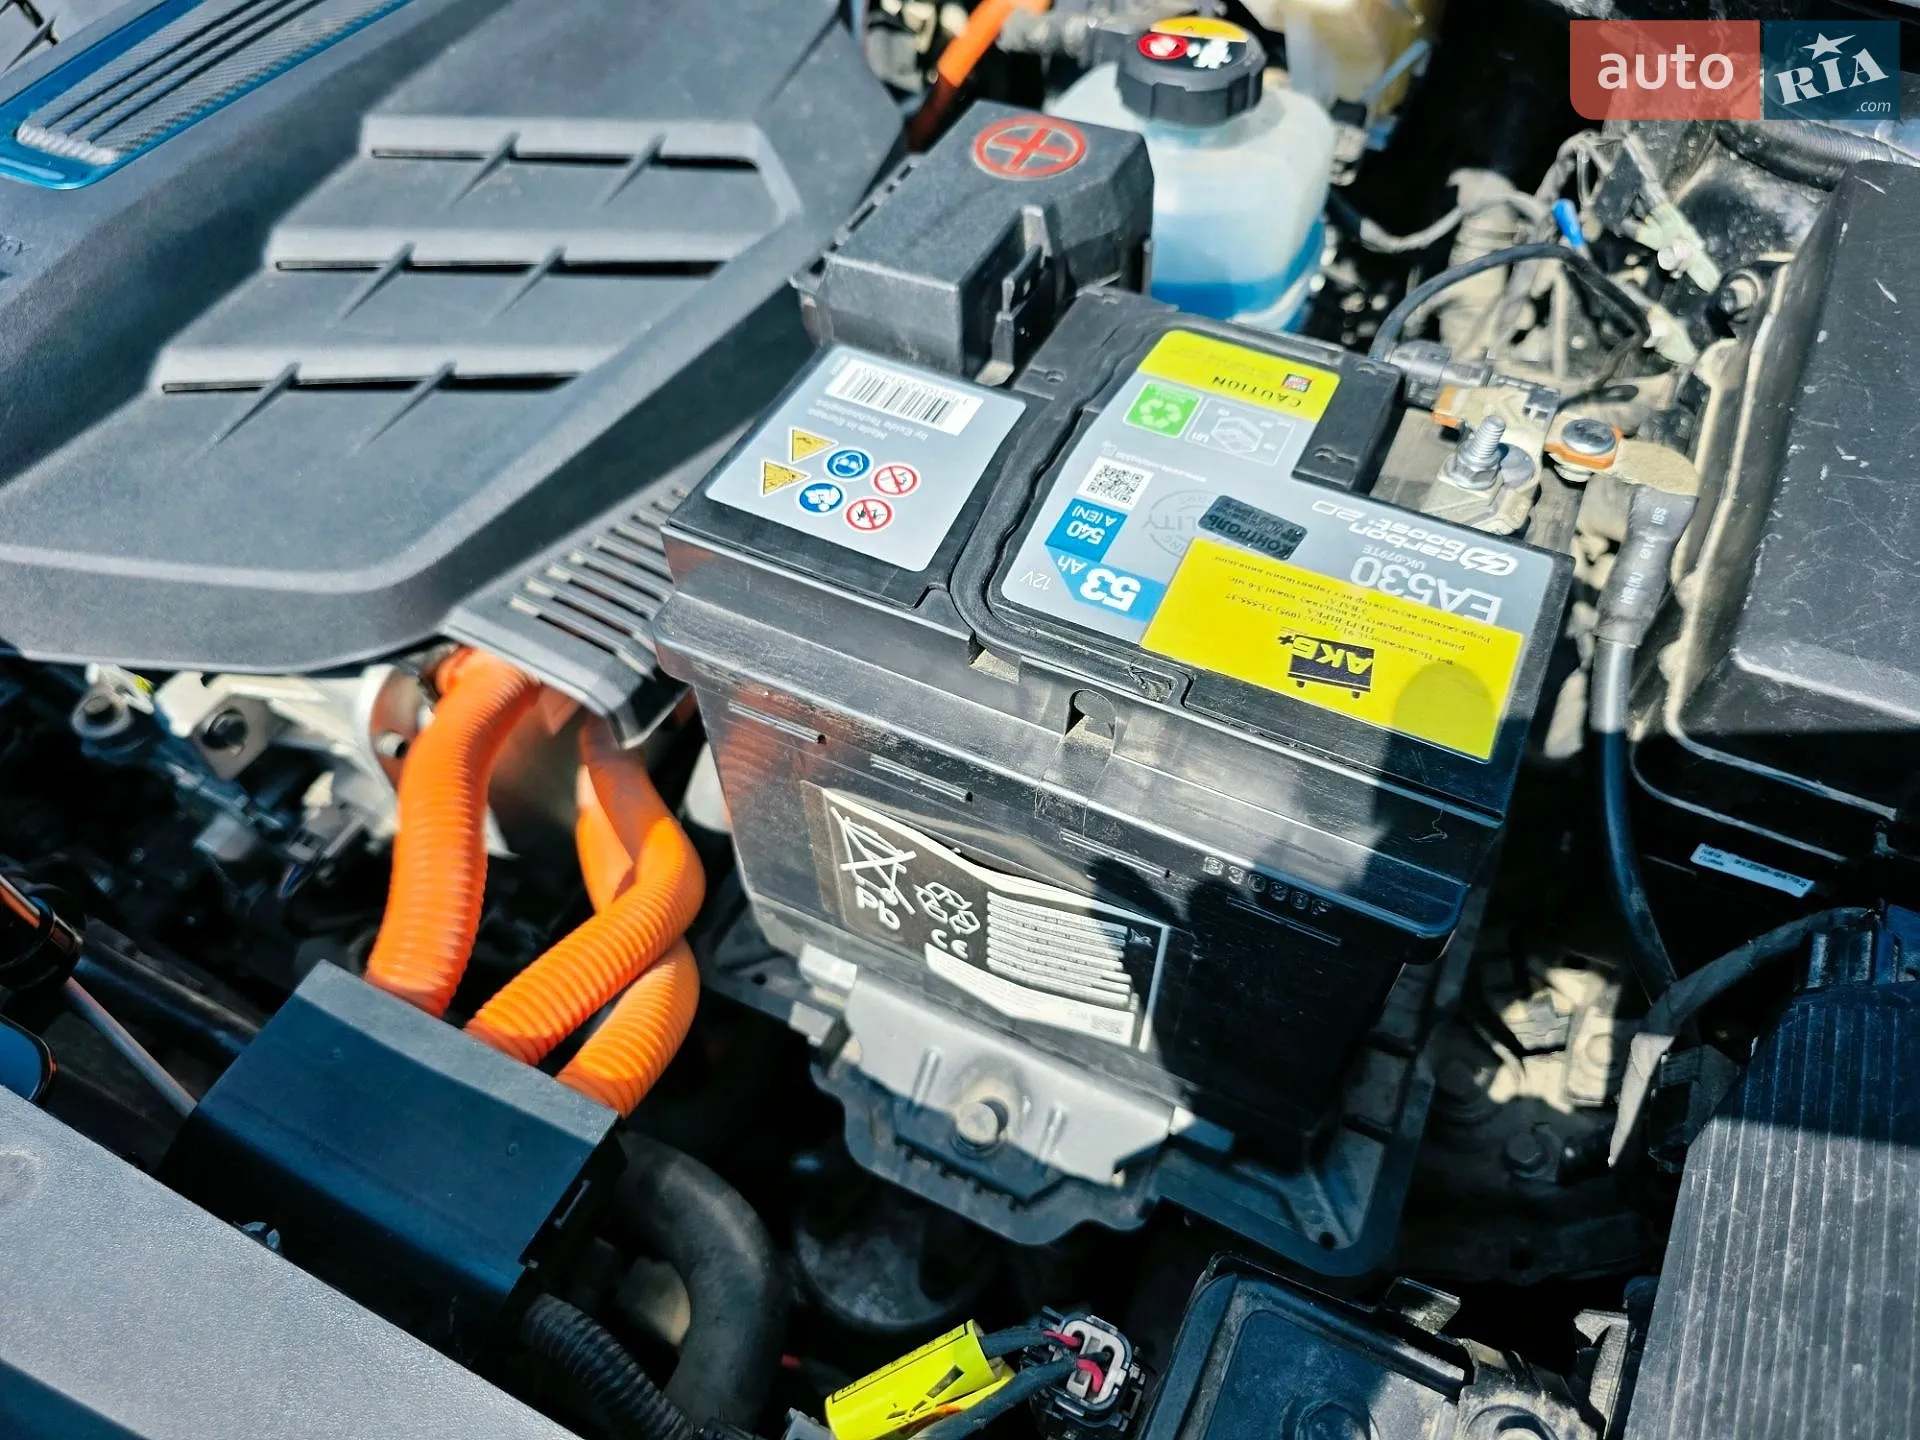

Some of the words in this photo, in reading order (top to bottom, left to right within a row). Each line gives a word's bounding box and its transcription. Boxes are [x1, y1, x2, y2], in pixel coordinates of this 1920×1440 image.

[1213, 375, 1302, 408] CAUTION
[1072, 504, 1103, 524] (EN)
[1102, 514, 1117, 528] A
[1066, 522, 1106, 545] 540
[1203, 514, 1294, 559] КОНТРОЛЬ
[1056, 554, 1087, 576] Ah
[1020, 569, 1053, 591] 12V
[1079, 567, 1141, 612] 53
[1350, 555, 1503, 623] EA530
[855, 886, 901, 931] Pb
